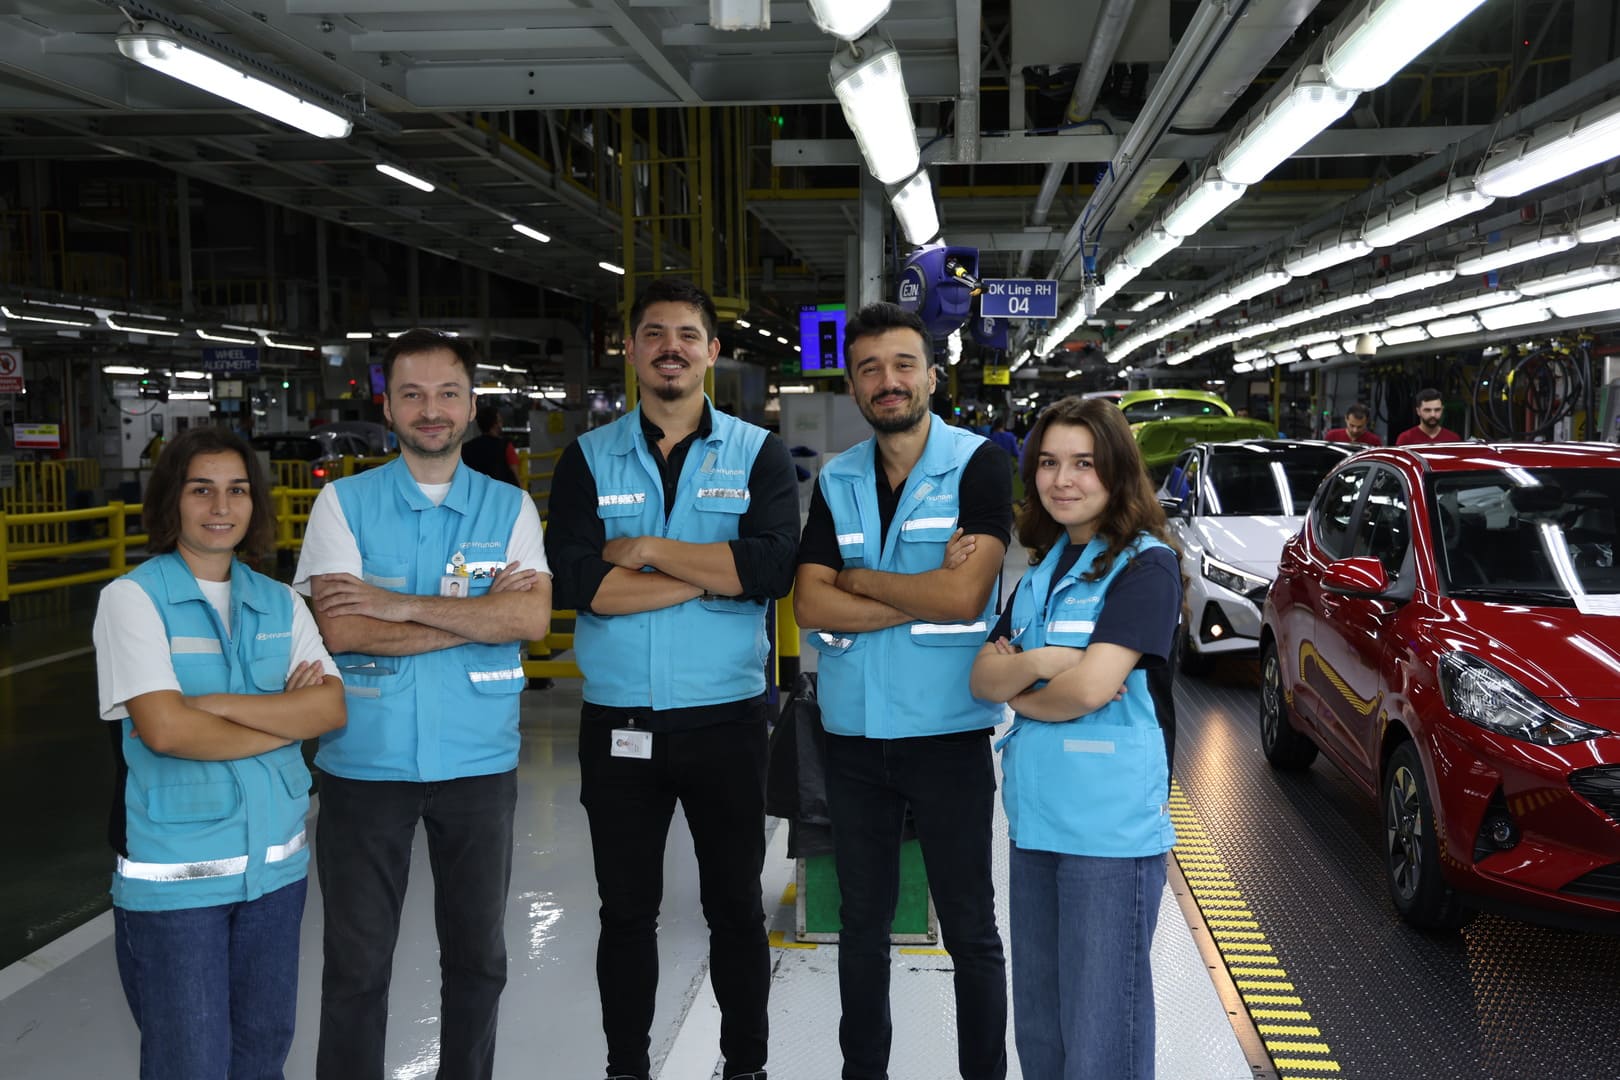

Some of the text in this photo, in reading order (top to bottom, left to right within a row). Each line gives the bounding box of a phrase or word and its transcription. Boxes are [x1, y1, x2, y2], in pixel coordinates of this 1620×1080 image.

[989, 284, 1051, 295] OK Line RH
[1008, 297, 1030, 314] 04
[215, 350, 246, 360] WHEEL
